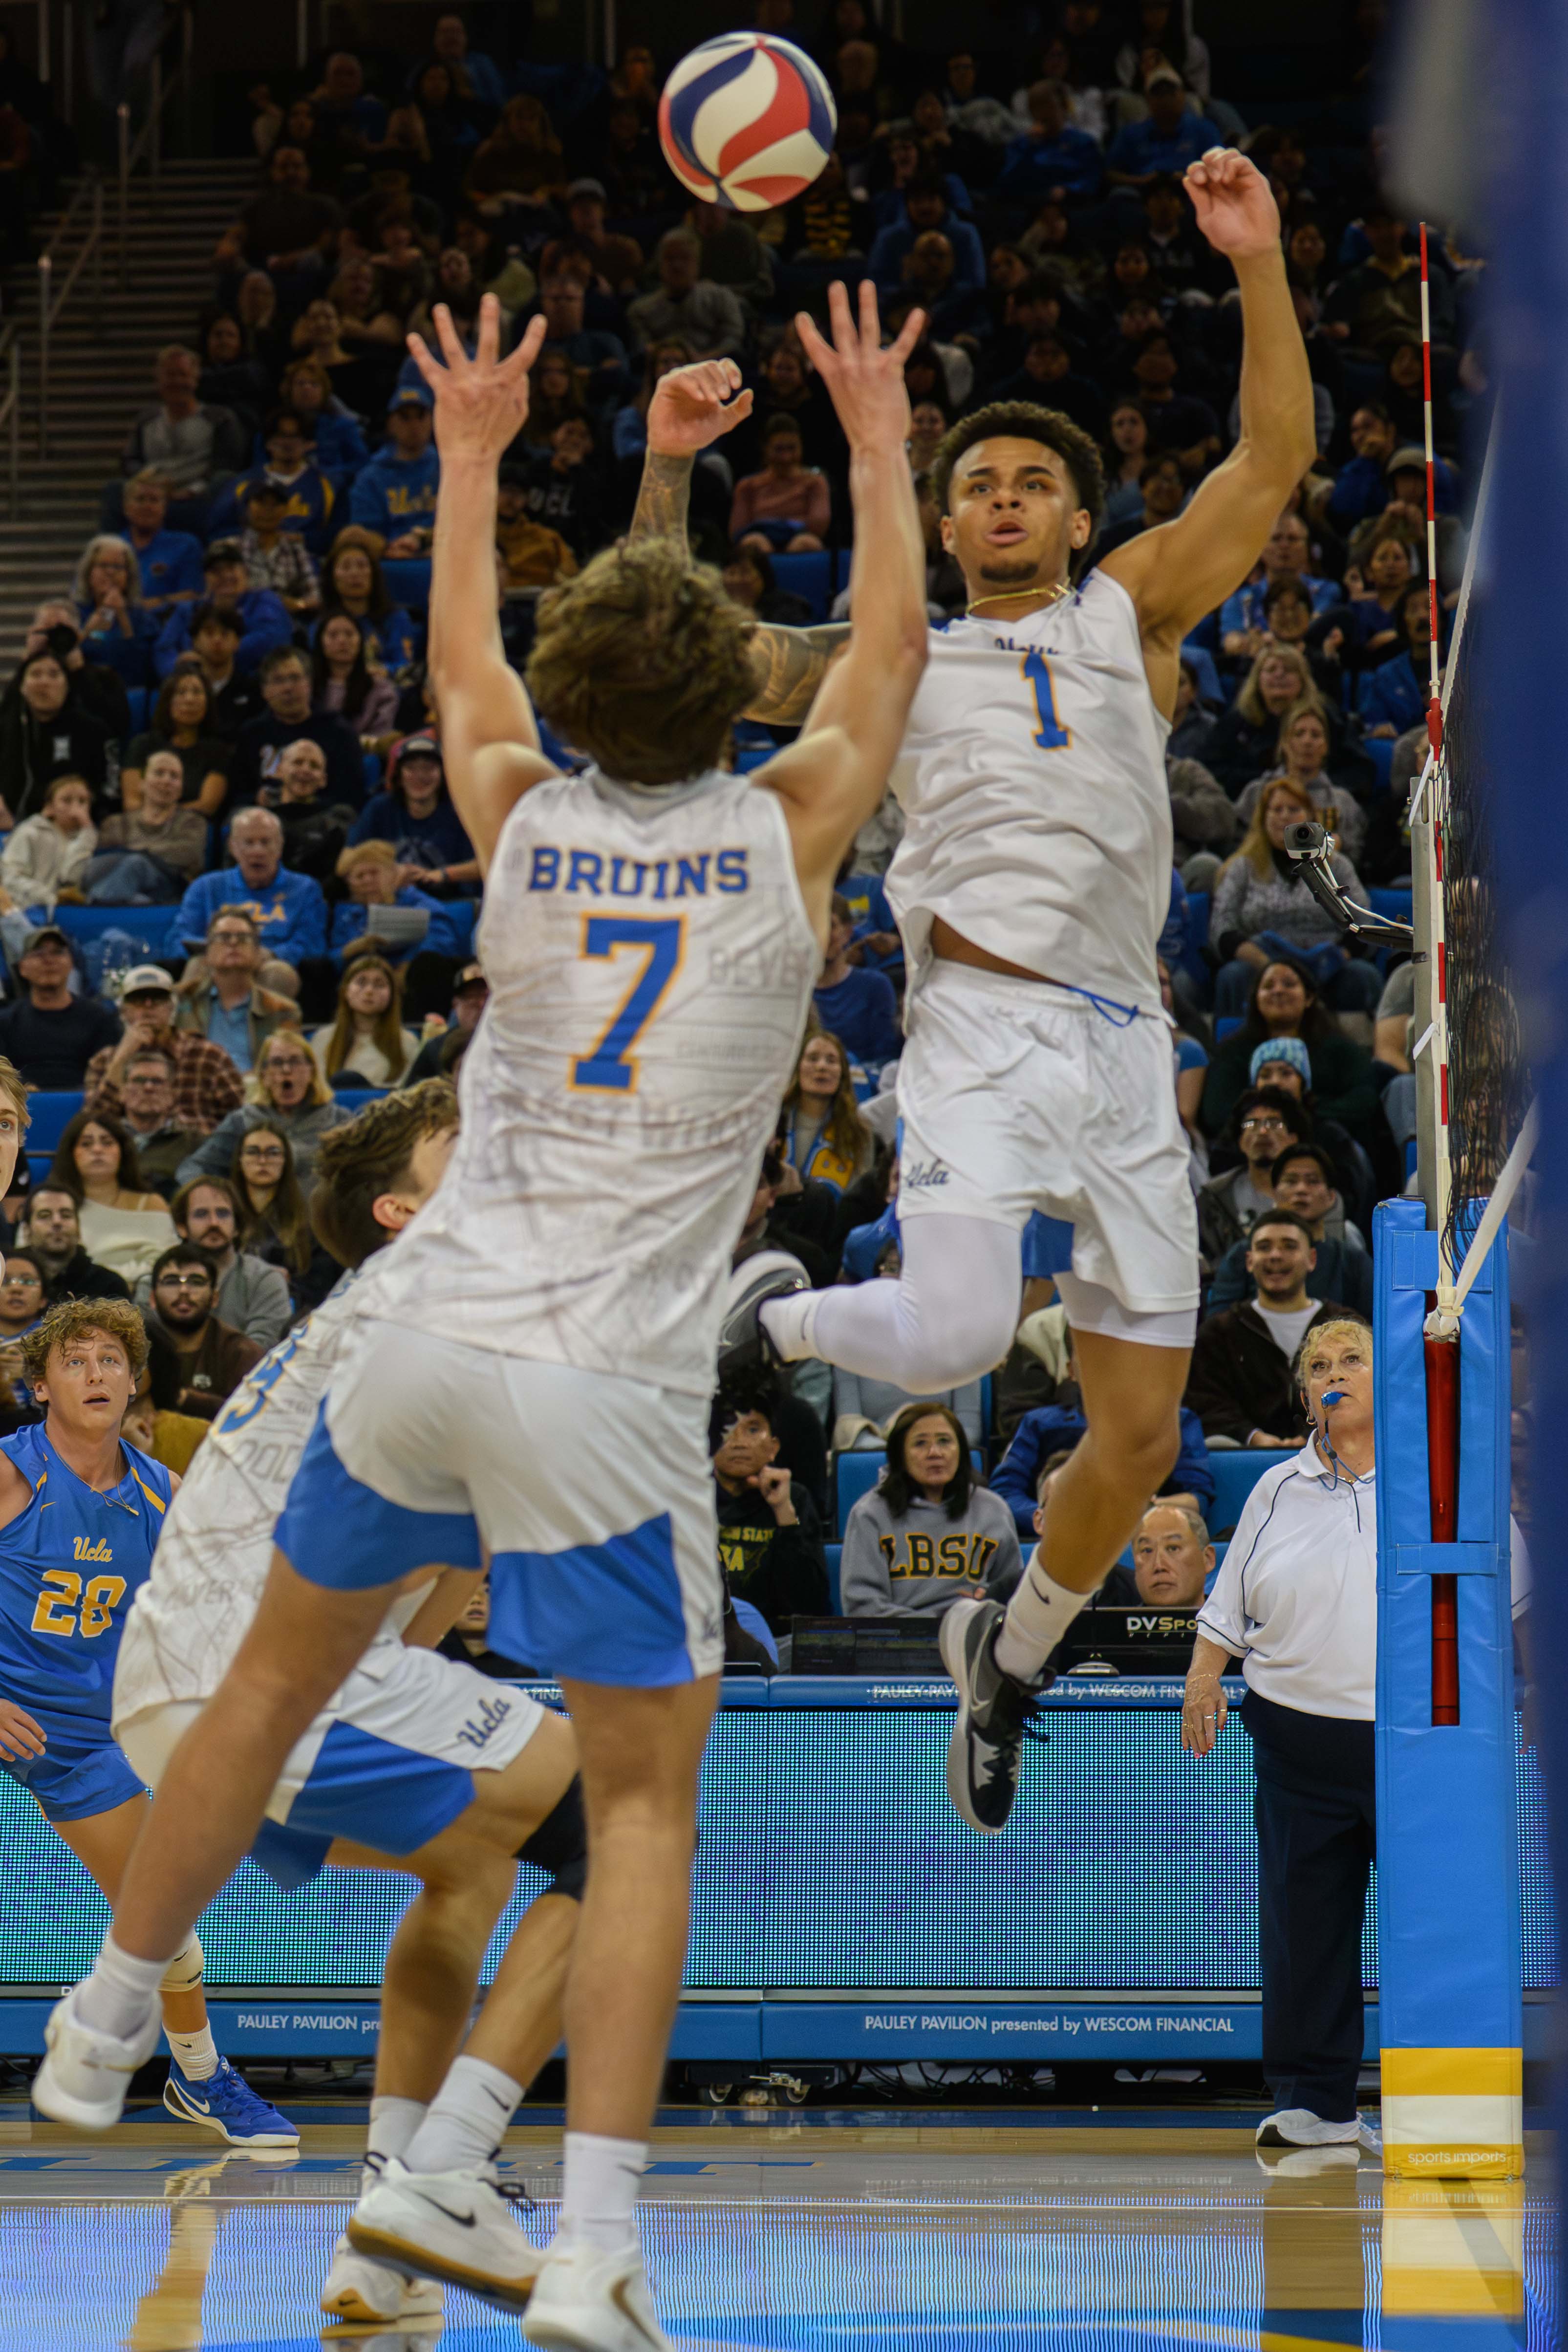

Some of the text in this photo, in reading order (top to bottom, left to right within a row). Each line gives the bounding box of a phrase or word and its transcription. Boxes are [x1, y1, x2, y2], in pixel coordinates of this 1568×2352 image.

[1019, 652, 1073, 752] 1
[527, 845, 750, 900] BRUINS
[568, 912, 687, 1095] 7
[73, 1536, 113, 1562] Ucla
[879, 1532, 999, 1584] LBSU
[31, 1569, 128, 1639] 28
[873, 1684, 924, 1698] PAULEY
[1068, 1682, 1086, 1701] by
[1089, 1683, 1156, 1698] WESCOM
[457, 1698, 511, 1748] Ucla
[238, 2015, 289, 2028] PAULEY
[293, 2015, 358, 2030] PAVILION
[865, 2015, 1234, 2035] PAULEY PAVILION presented by WESCOM FINANCIAL
[1408, 2151, 1506, 2165] sports imports
